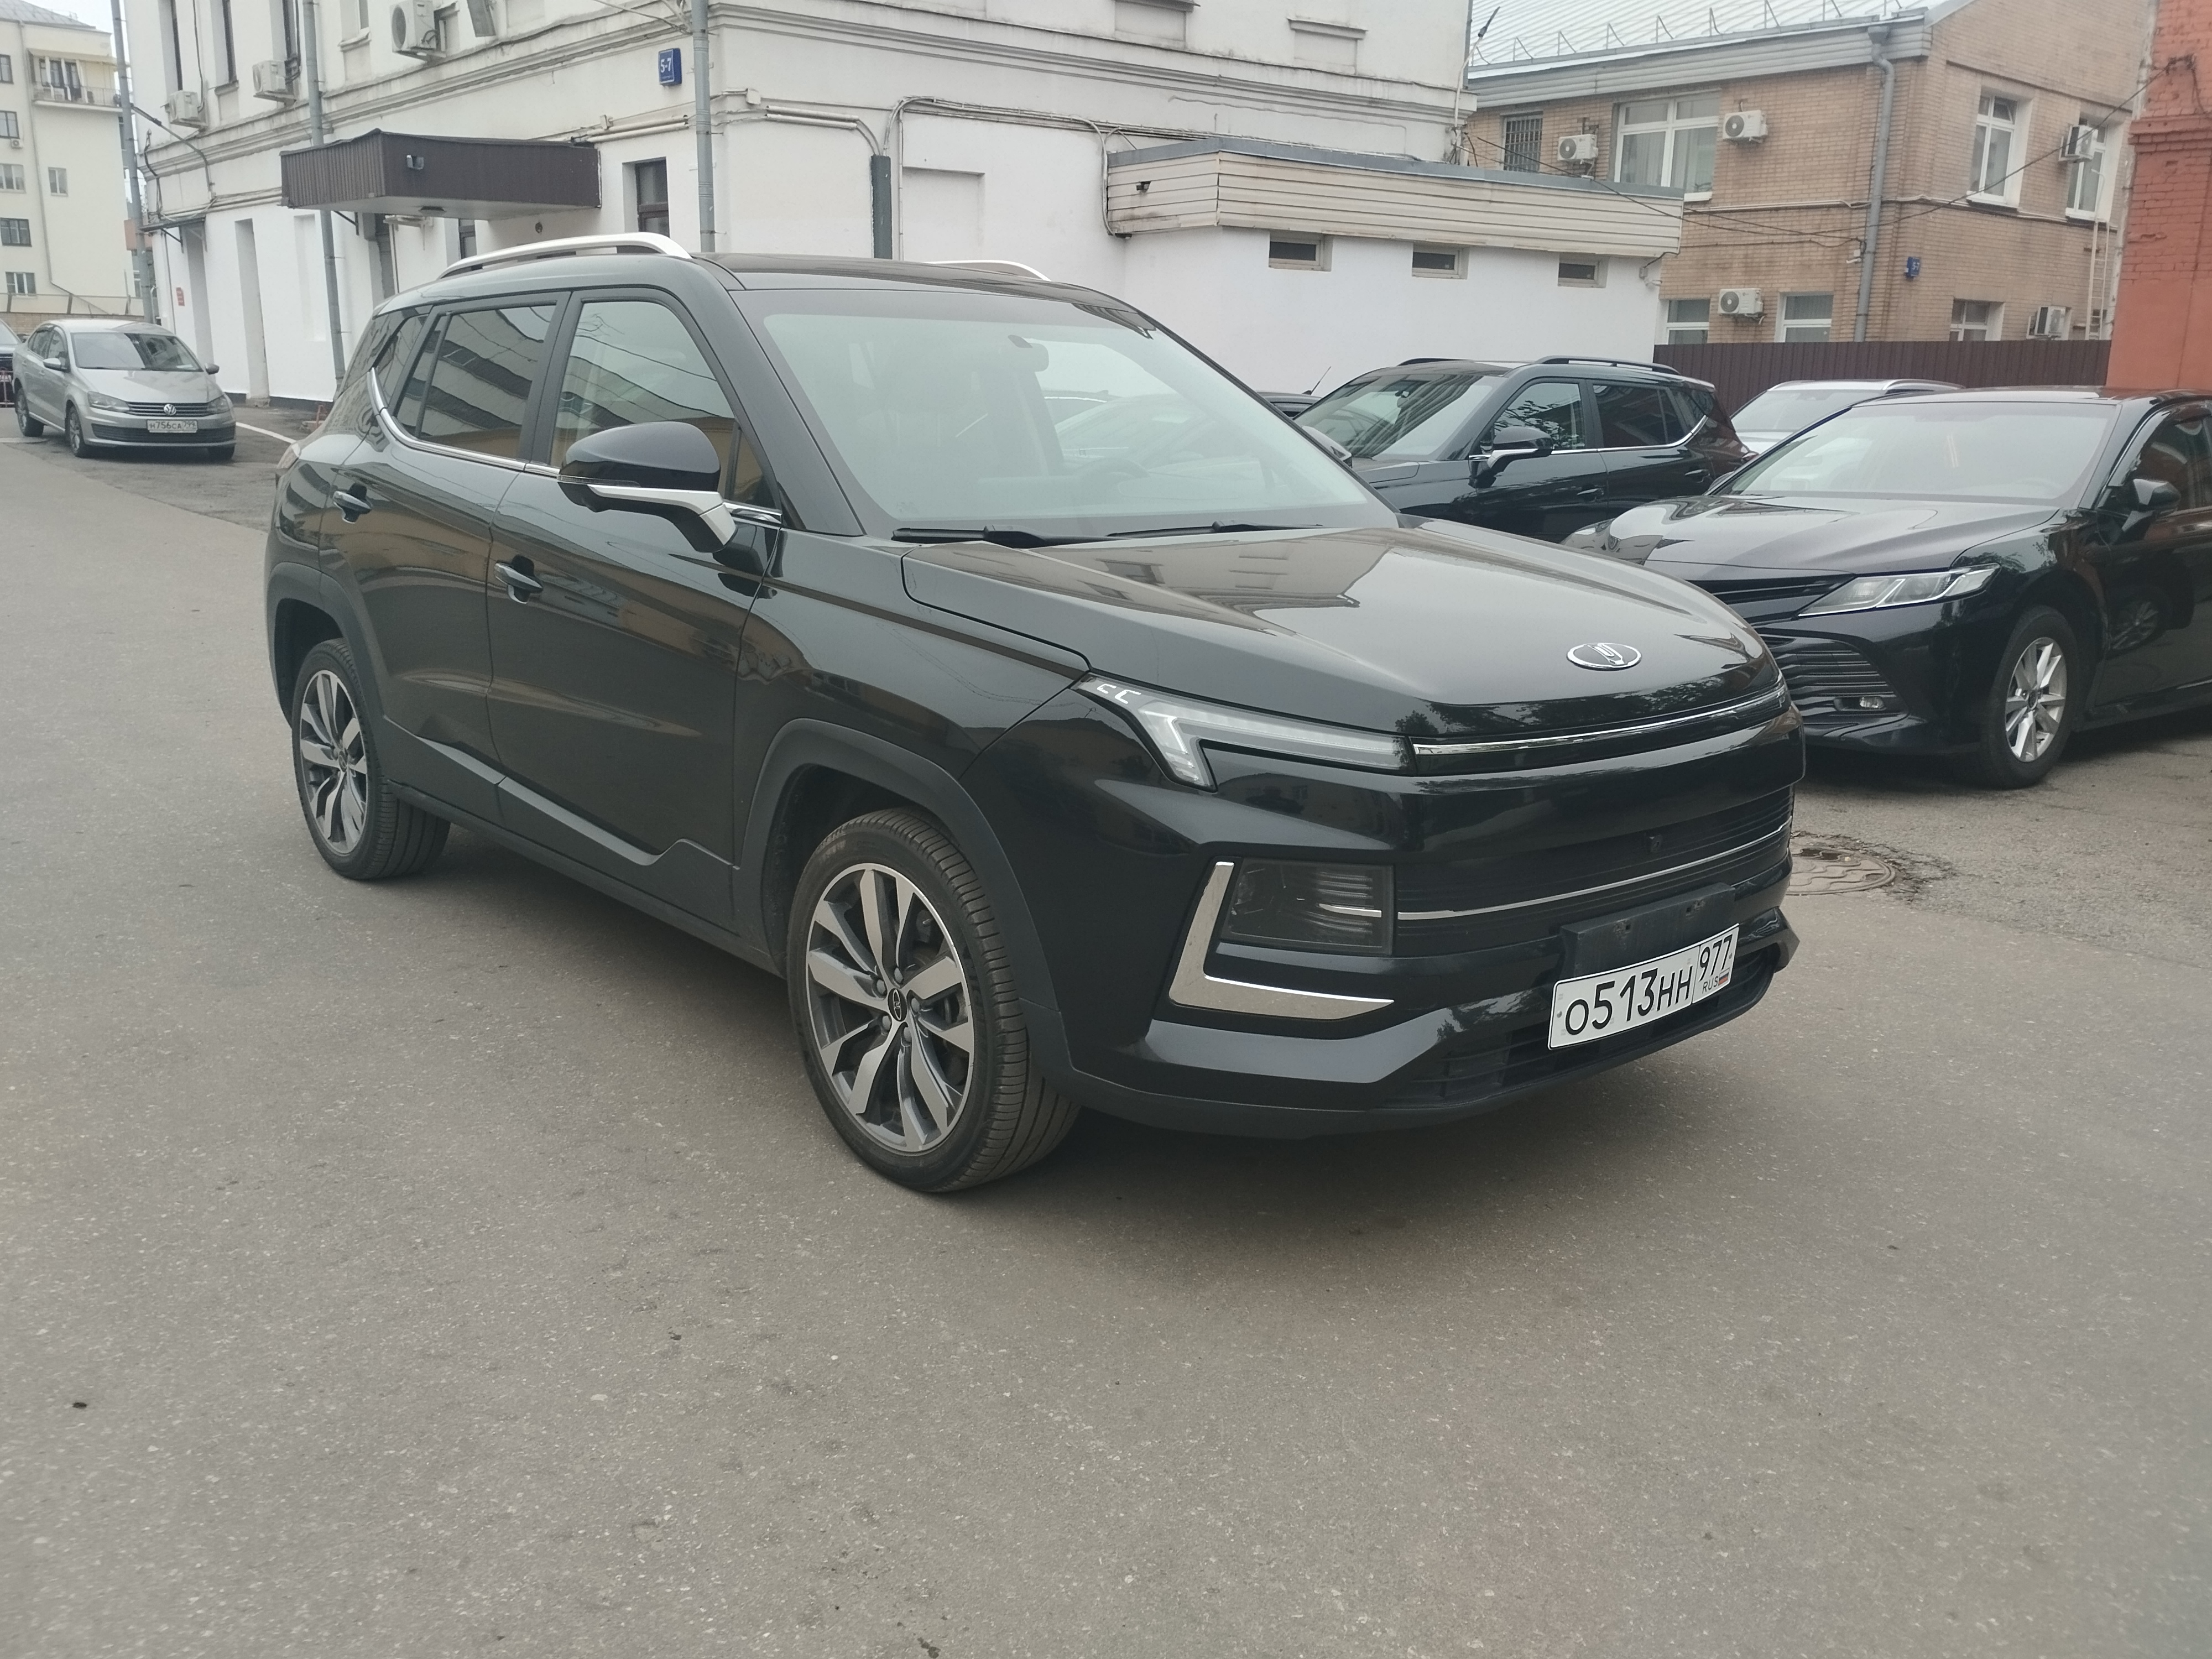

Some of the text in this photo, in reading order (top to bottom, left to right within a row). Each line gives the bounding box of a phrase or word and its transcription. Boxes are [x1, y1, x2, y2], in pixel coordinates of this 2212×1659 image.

[661, 58, 672, 73] 5-7
[1565, 933, 1733, 1035] О513НН 977
[1702, 976, 1719, 994] RUS
